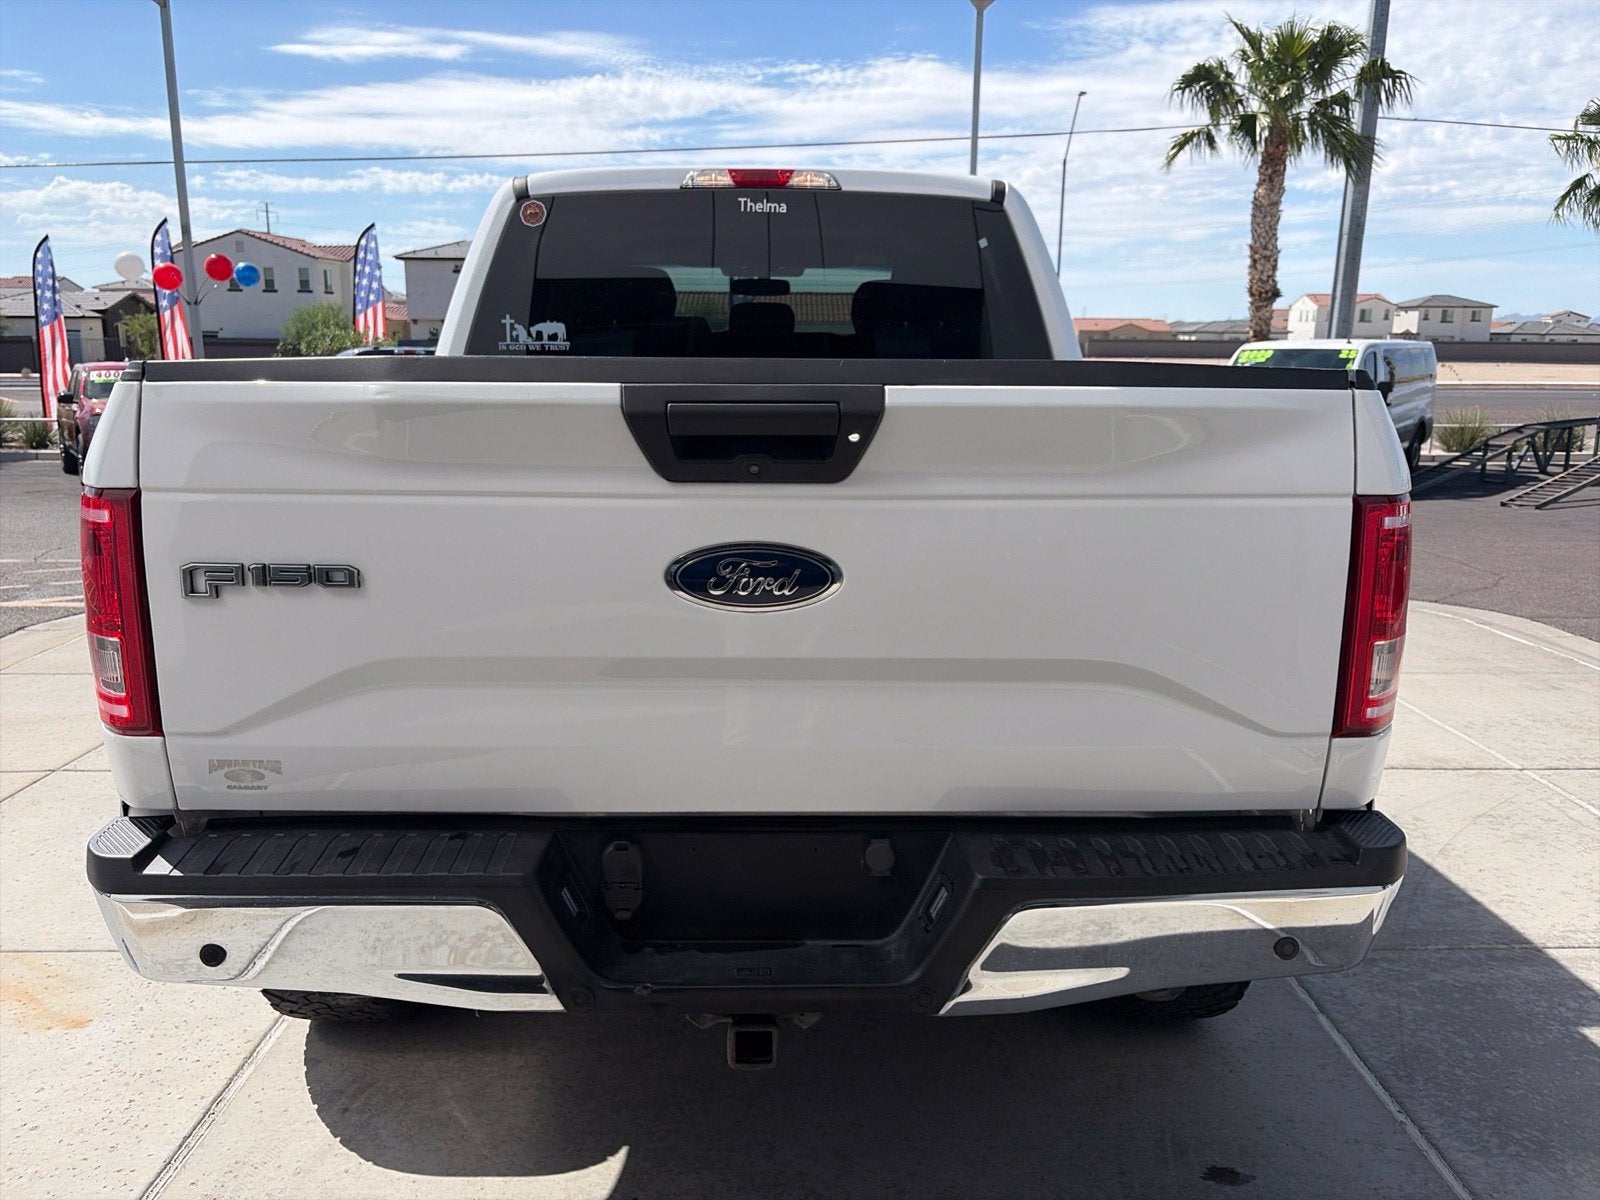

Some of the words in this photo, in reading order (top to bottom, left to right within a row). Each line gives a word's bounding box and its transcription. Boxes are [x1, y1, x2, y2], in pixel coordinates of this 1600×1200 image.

[737, 197, 787, 213] Thelma
[706, 557, 802, 596] Ford
[208, 759, 283, 776] ADVANTAGE
